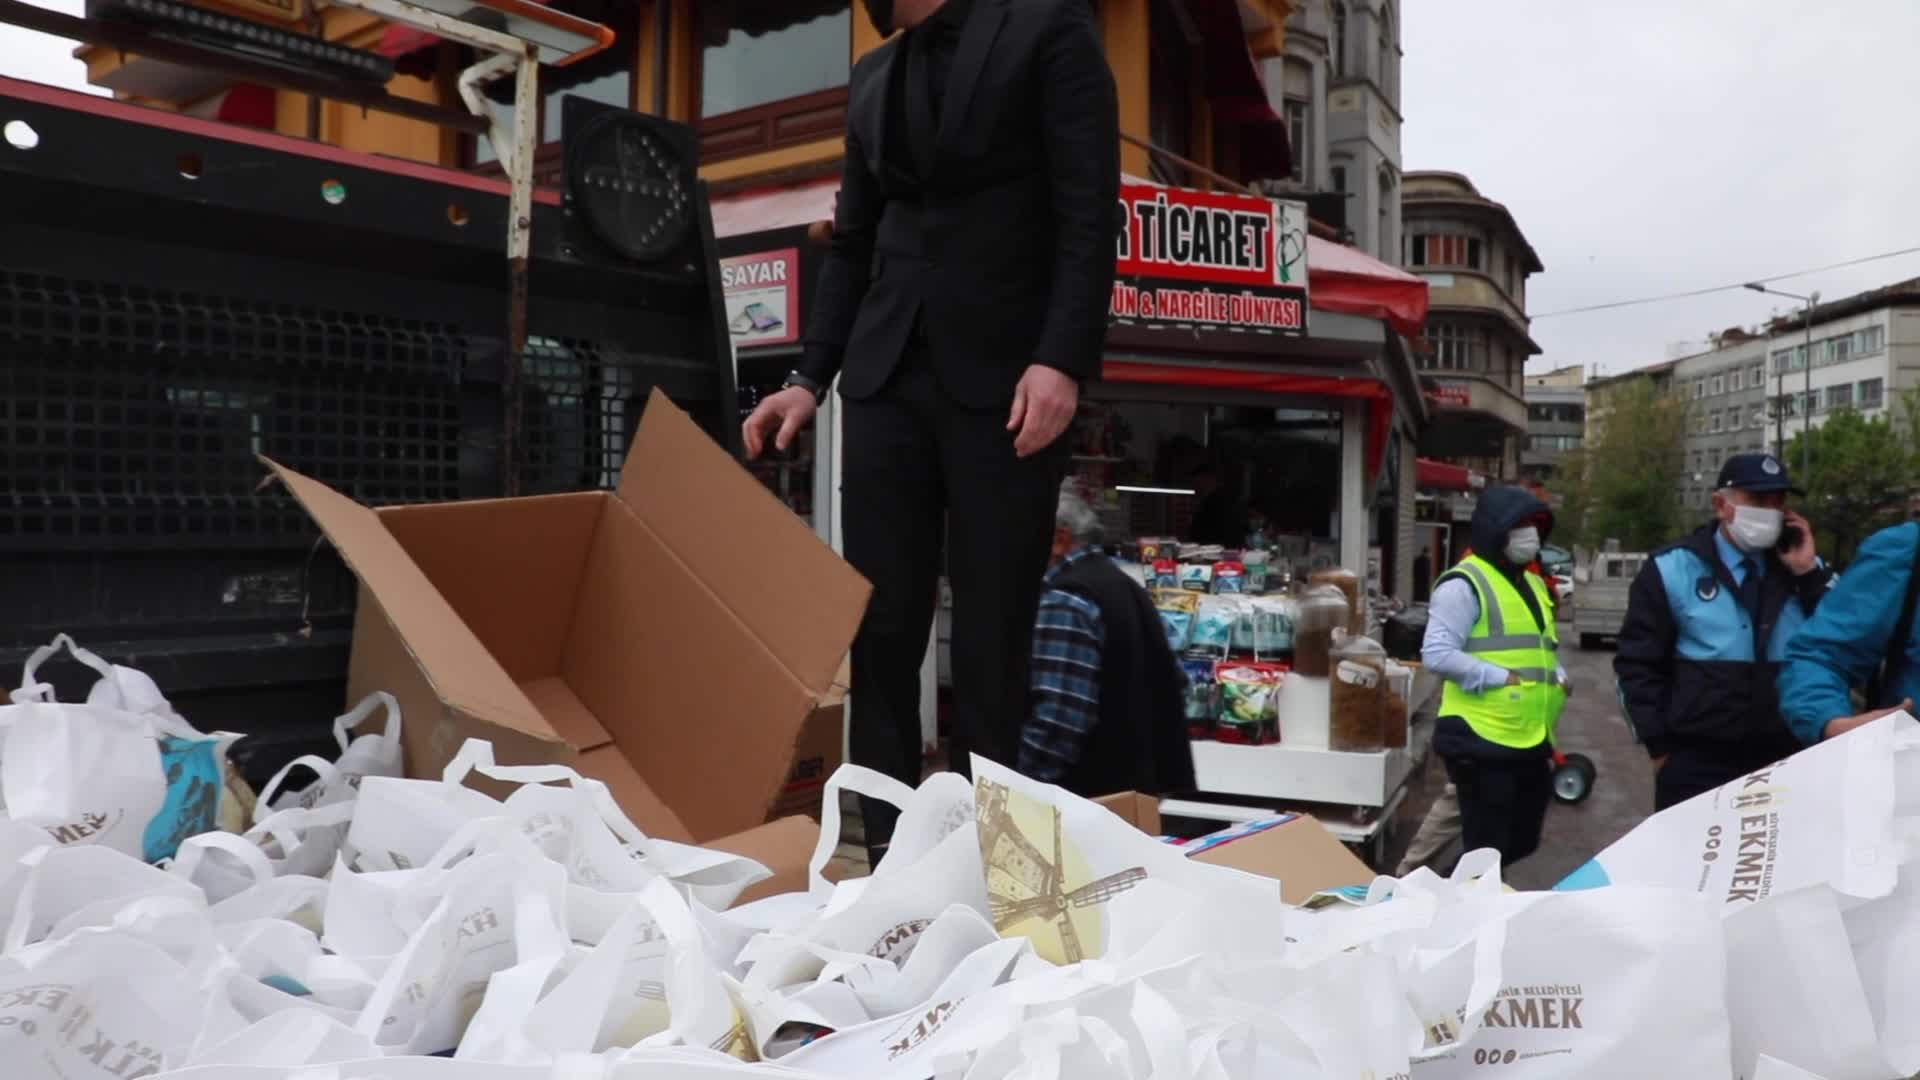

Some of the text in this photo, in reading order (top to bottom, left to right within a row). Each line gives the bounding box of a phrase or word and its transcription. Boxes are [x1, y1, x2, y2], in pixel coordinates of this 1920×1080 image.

[1134, 192, 1270, 272] TİCARET
[721, 259, 787, 289] SAYAR
[1110, 280, 1301, 329] ÜN & NARGİLE DÜNYASI
[1725, 813, 1768, 903] EKMEK
[1478, 998, 1585, 1029] KMEK
